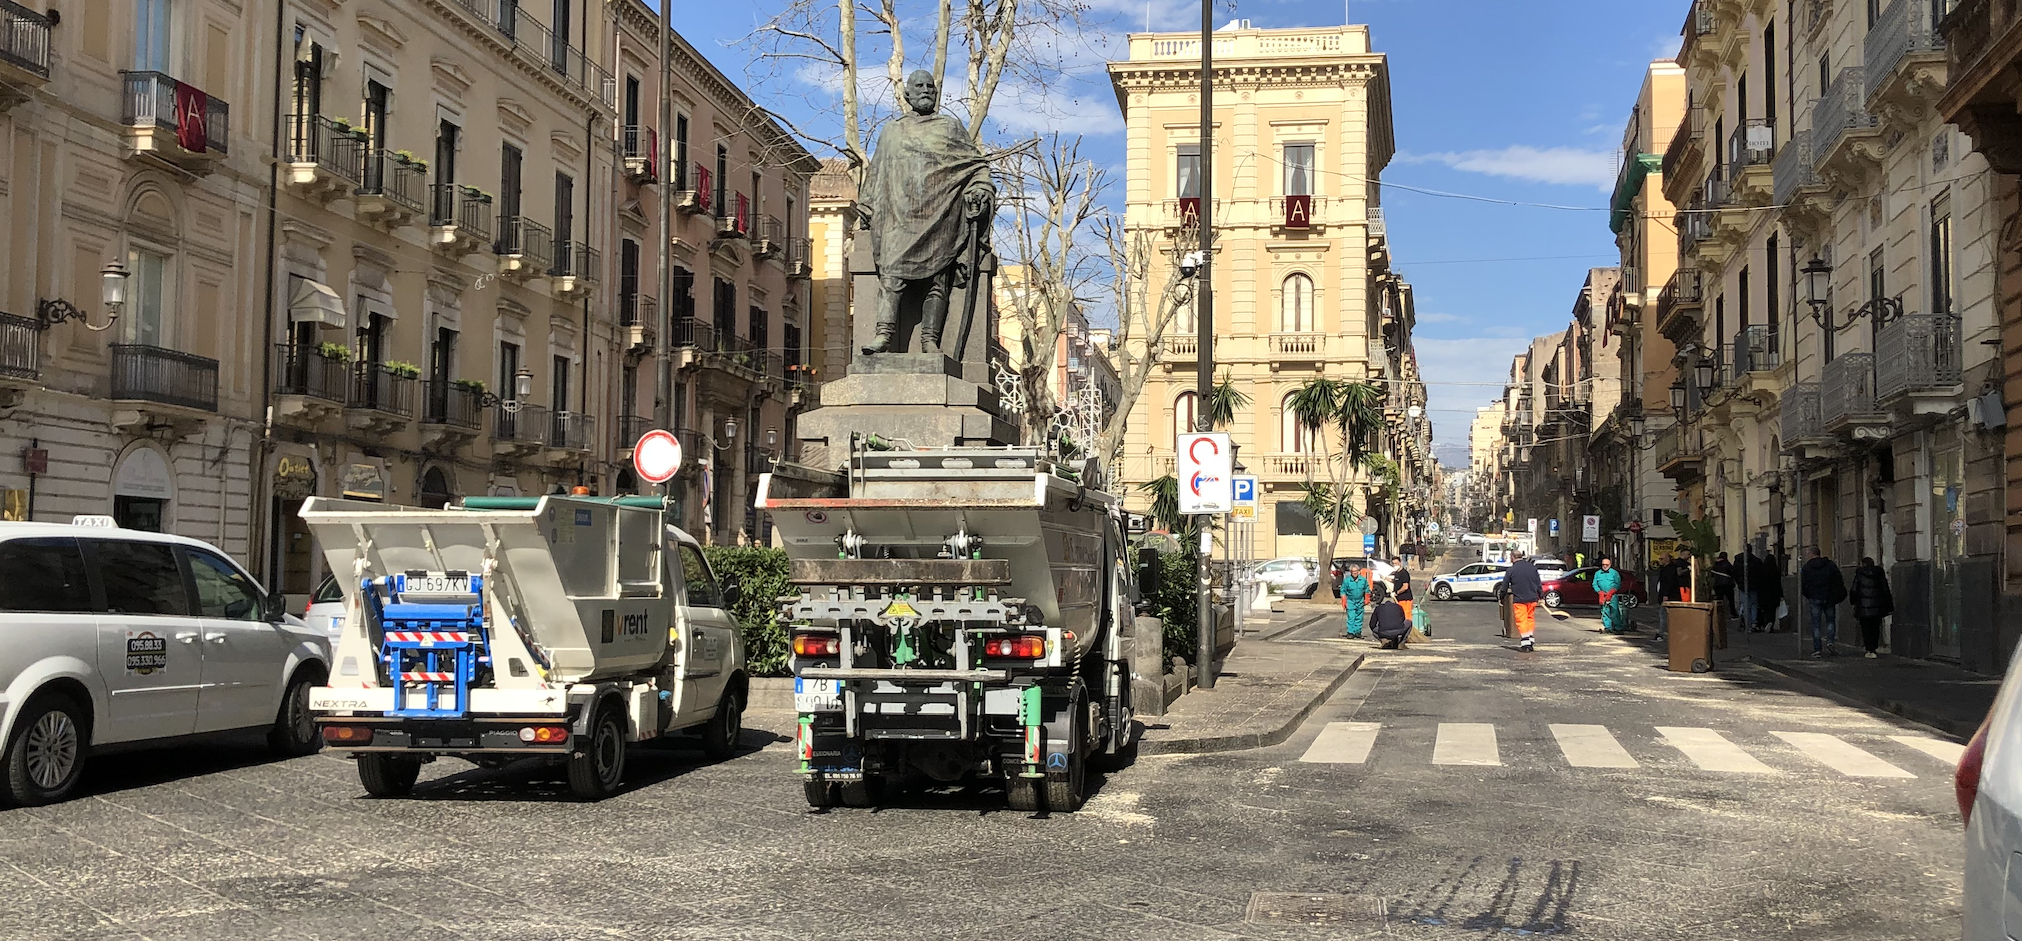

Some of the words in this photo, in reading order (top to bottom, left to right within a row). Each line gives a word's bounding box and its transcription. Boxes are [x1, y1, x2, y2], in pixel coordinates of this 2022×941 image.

[185, 93, 205, 136] A
[1184, 201, 1198, 224] A
[1290, 199, 1306, 222] A
[1234, 480, 1251, 500] P
[75, 517, 109, 527] TAXI
[616, 609, 648, 636] vrent
[313, 700, 368, 708] NEXTRA
